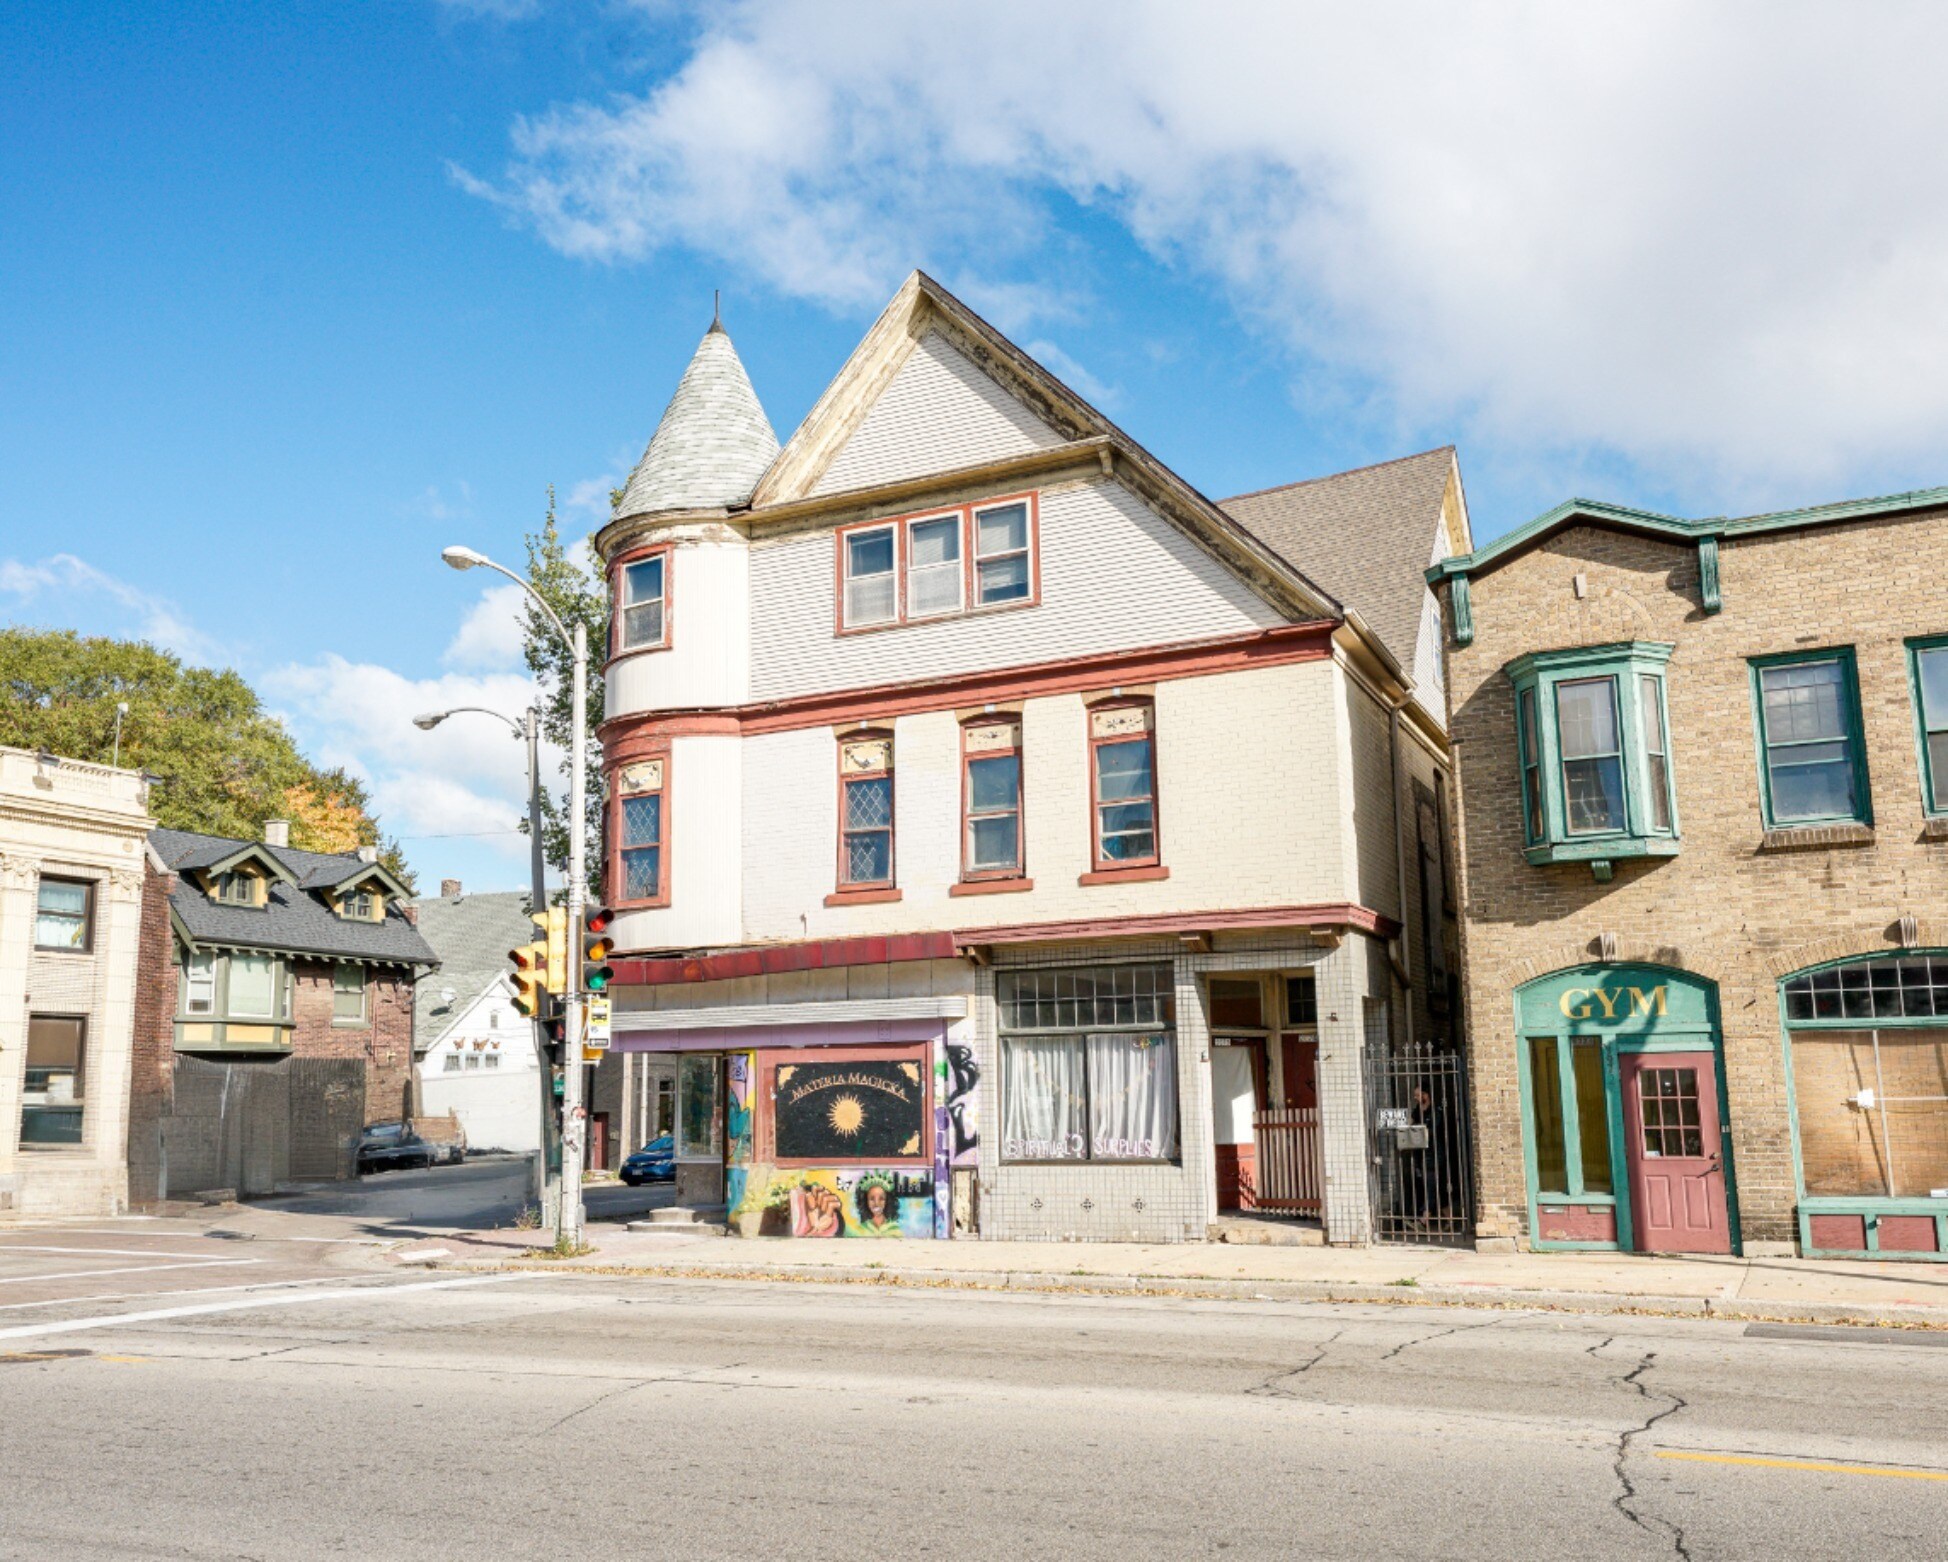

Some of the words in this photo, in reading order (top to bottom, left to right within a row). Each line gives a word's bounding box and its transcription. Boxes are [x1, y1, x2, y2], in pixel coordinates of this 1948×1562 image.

[1559, 985, 1669, 1019] GYM
[791, 1073, 845, 1100] MATERIA
[848, 1072, 906, 1099] MAGICKA
[1007, 1138, 1071, 1156] SPIRITUAL
